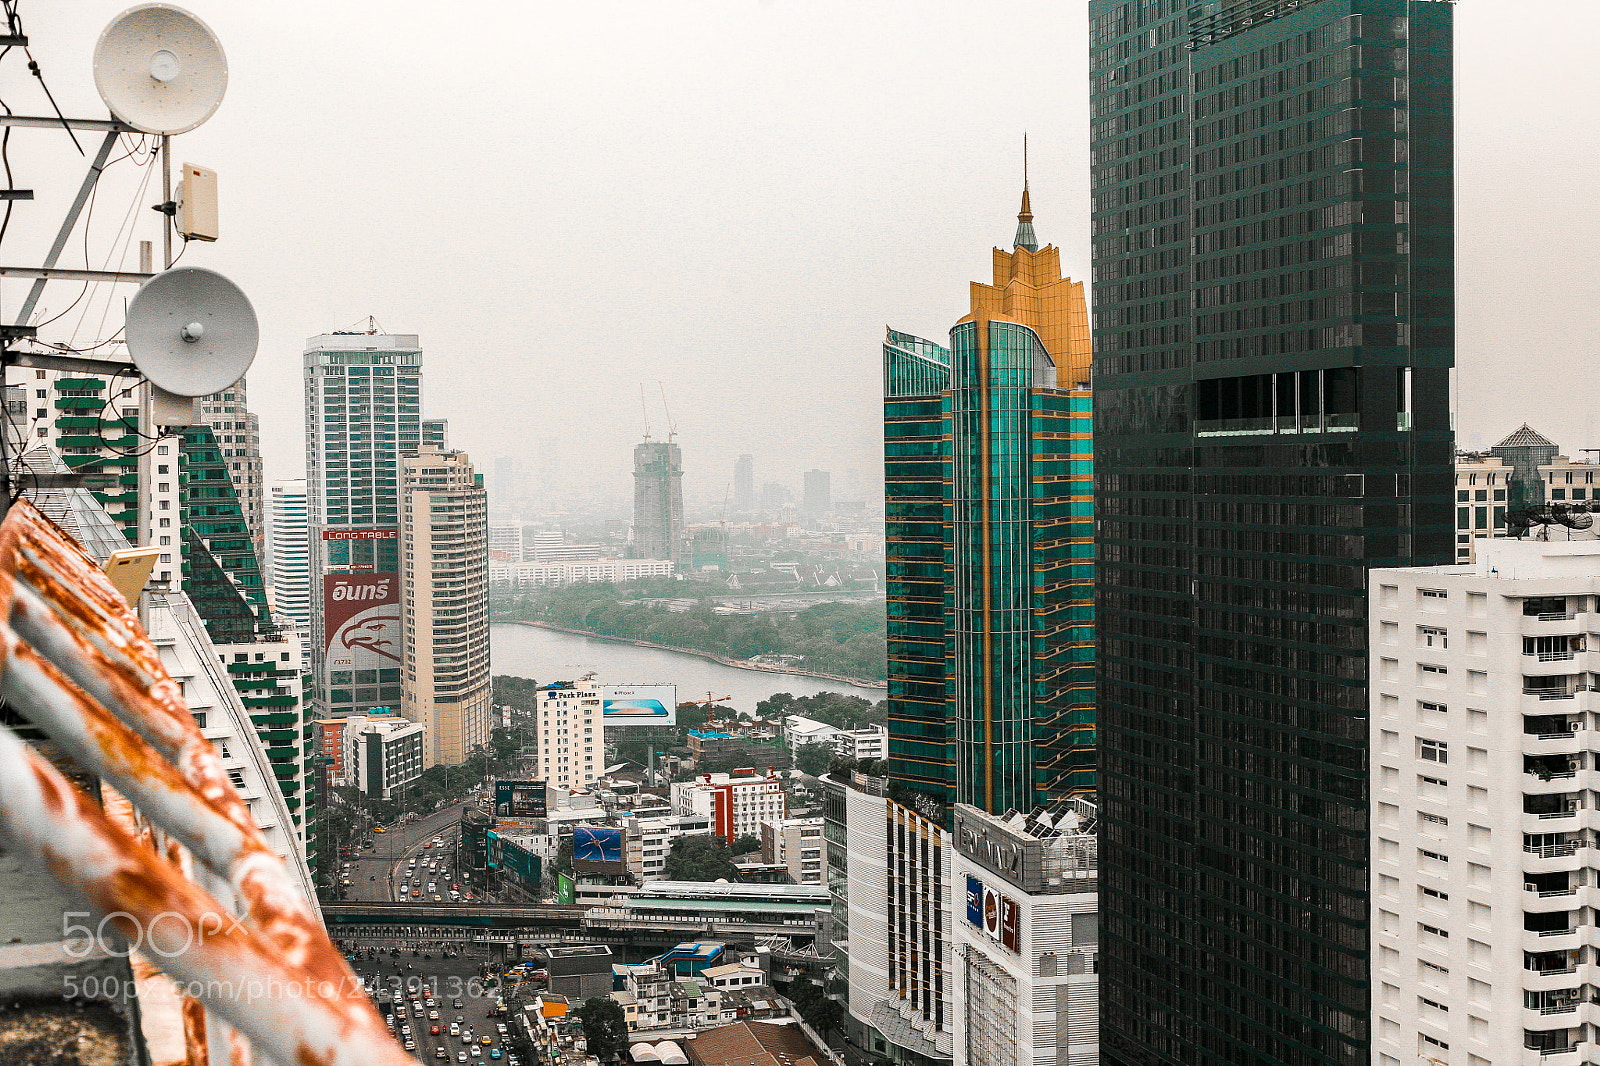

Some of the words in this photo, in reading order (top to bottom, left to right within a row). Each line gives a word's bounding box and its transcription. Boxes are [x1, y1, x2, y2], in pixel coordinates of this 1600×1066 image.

[332, 578, 391, 601] อินทรี
[558, 691, 576, 699] Park
